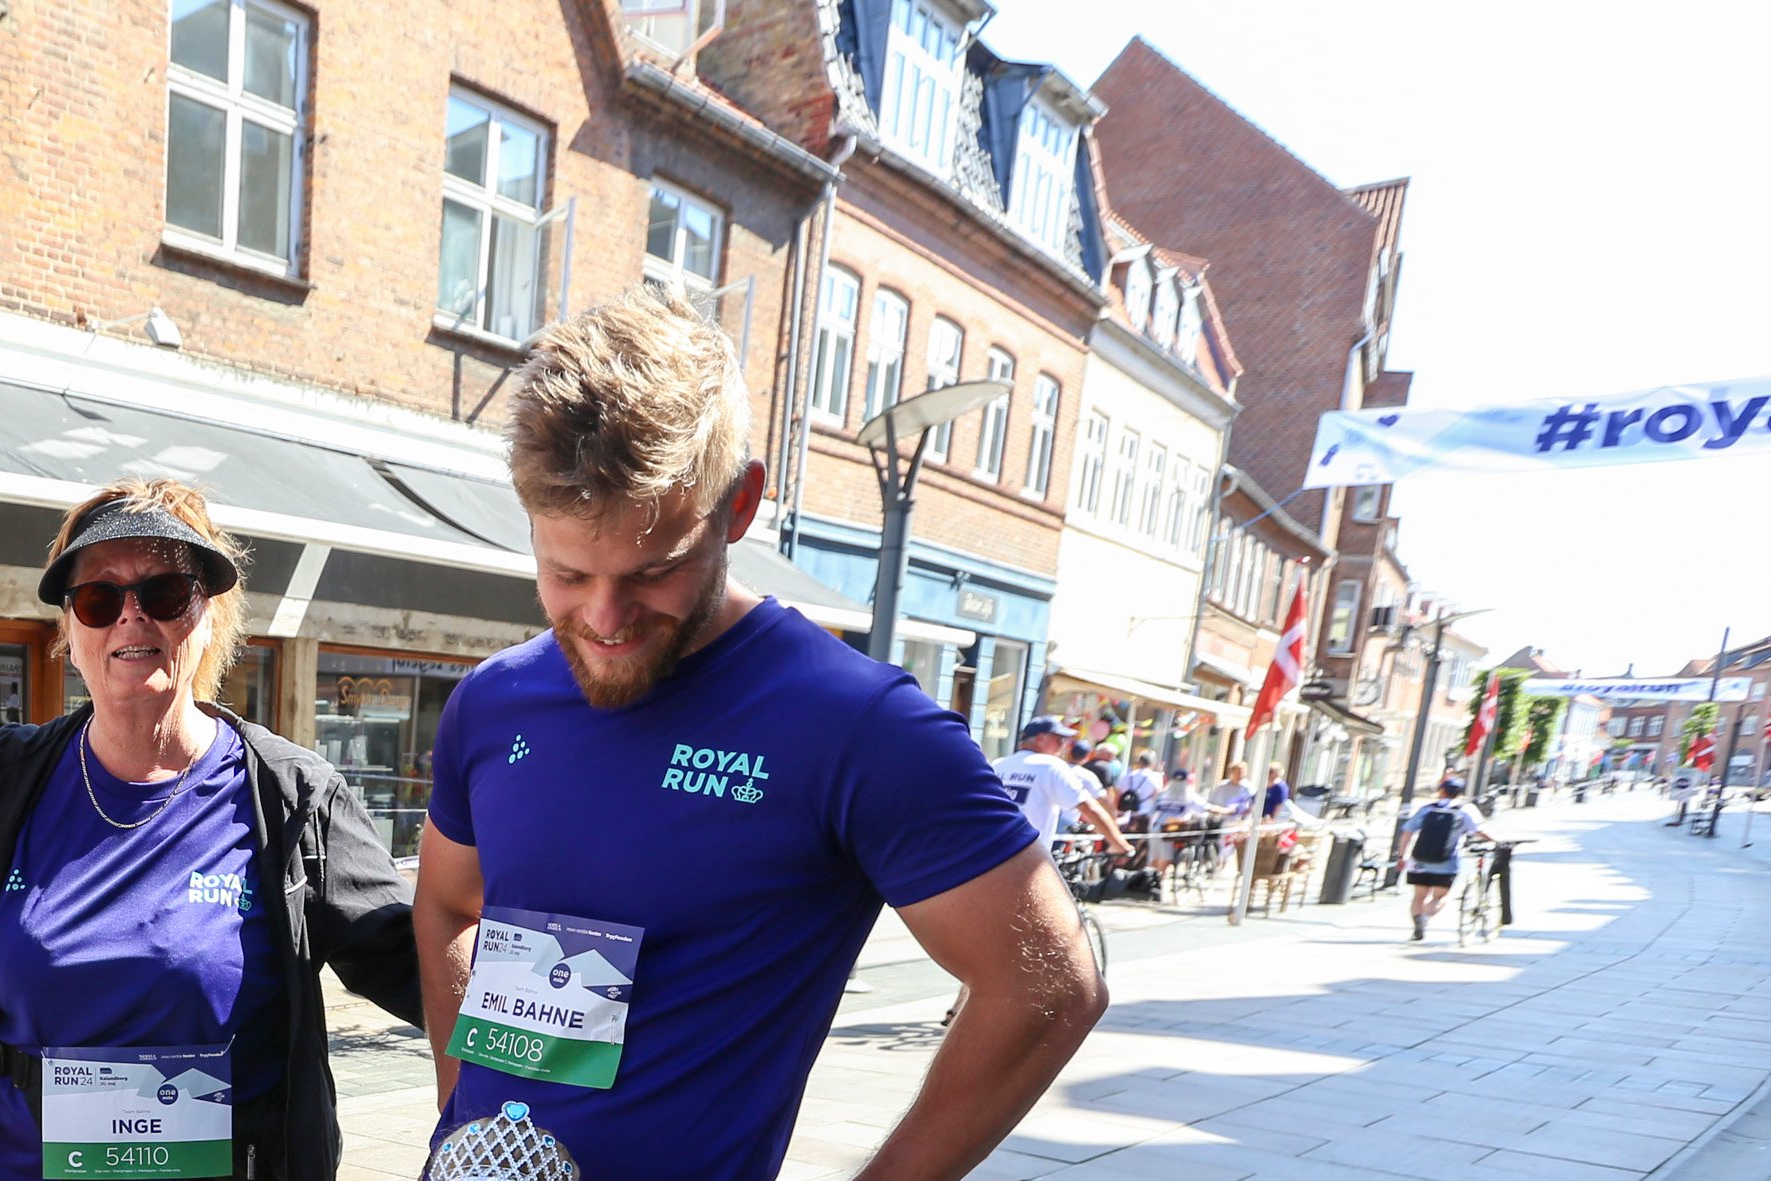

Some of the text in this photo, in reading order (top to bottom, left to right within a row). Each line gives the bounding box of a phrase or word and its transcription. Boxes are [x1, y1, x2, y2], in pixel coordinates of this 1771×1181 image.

[1538, 395, 1771, 450] #roy
[671, 744, 769, 780] ROYAL
[661, 768, 729, 798] RUN
[190, 871, 253, 895] ROYAL
[189, 888, 232, 907] RUN
[486, 929, 509, 942] ROYAL
[553, 969, 569, 978] one
[481, 992, 585, 1029] EMIL BAHNE
[466, 1028, 478, 1047] C
[486, 1028, 544, 1062] 54108
[55, 1067, 92, 1075] ROYAL
[55, 1077, 78, 1085] RUN
[112, 1119, 162, 1134] INGE
[68, 1146, 169, 1167] C 54110
